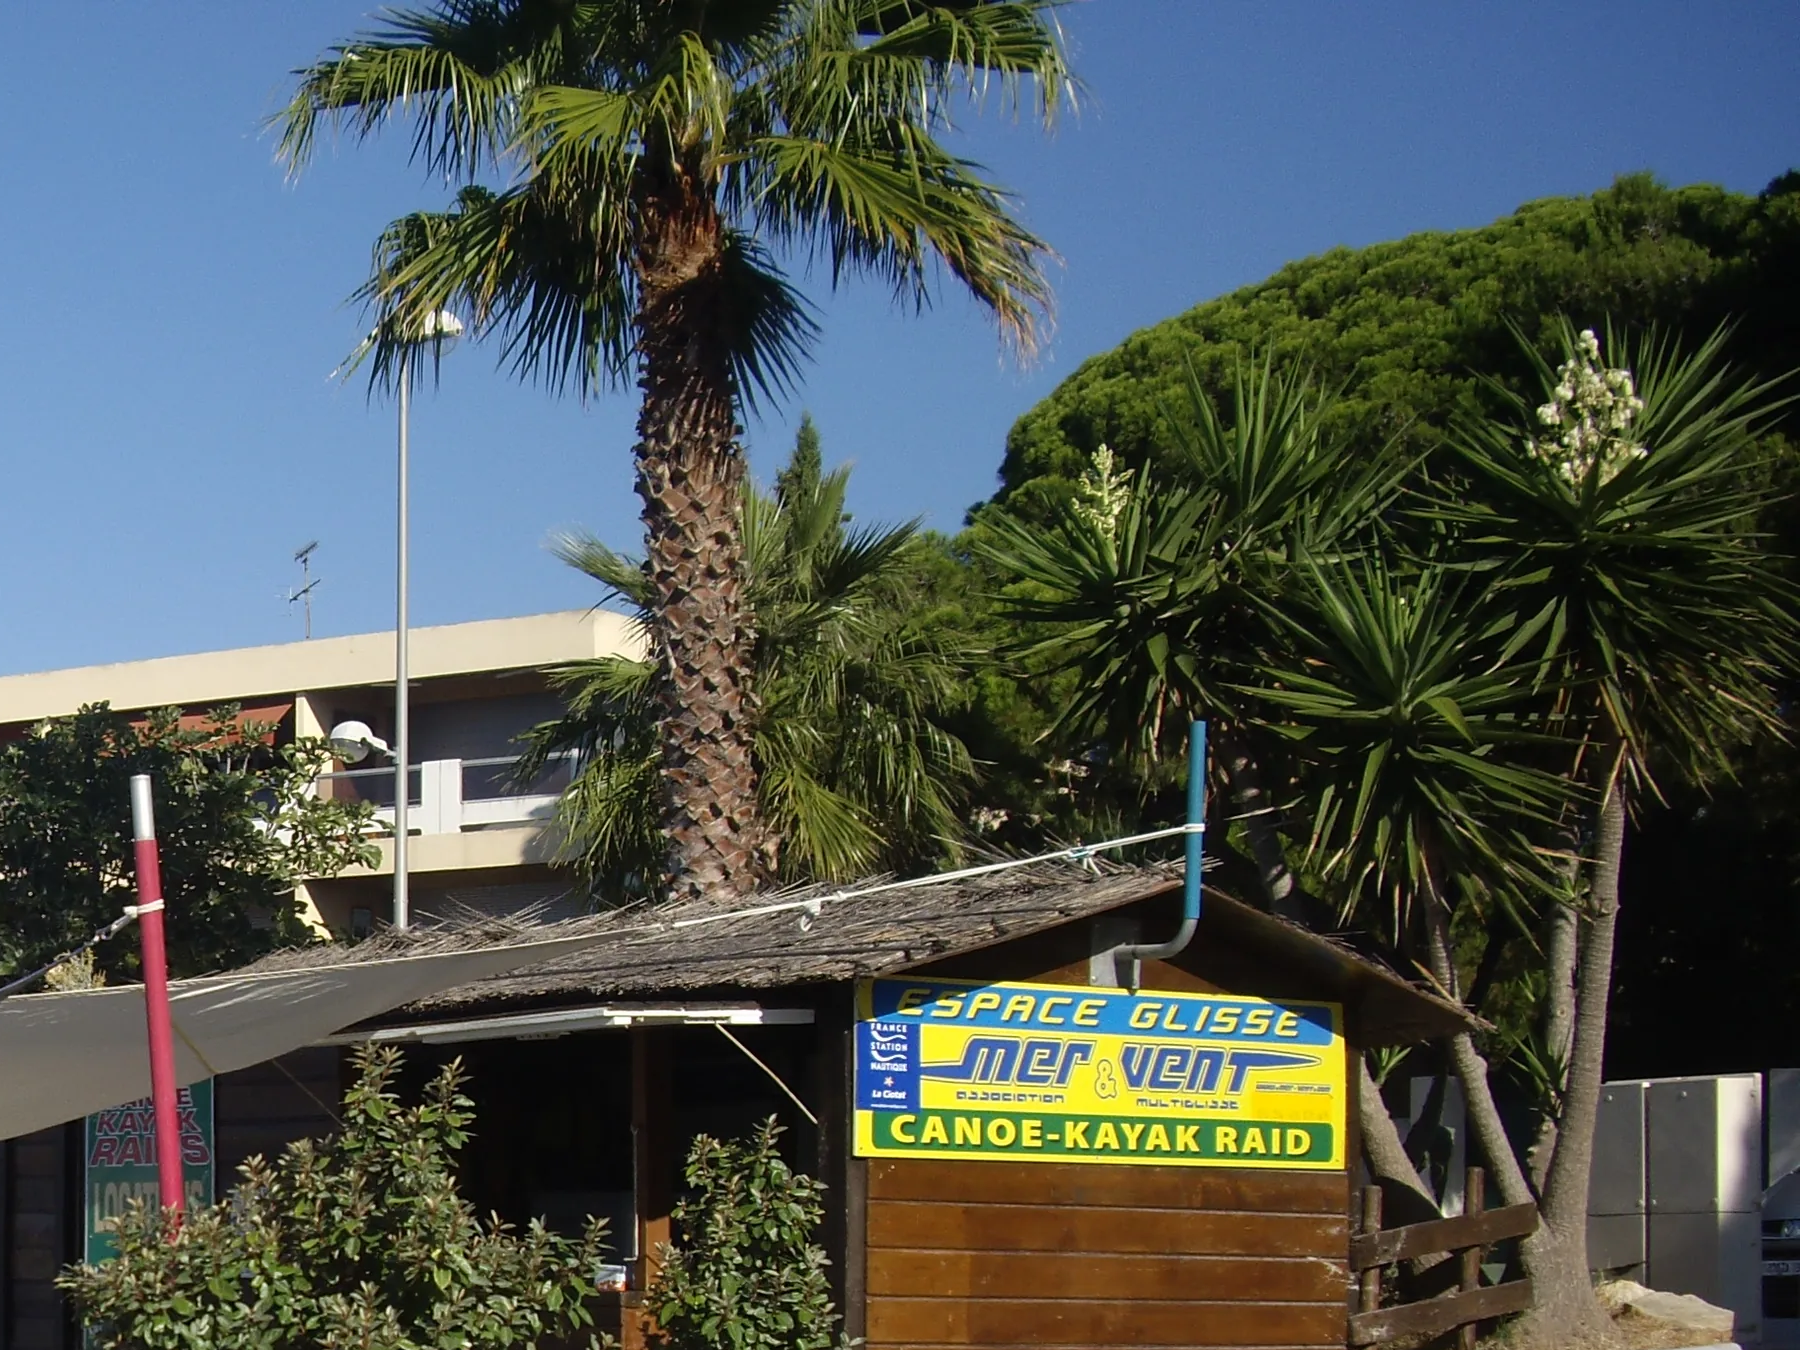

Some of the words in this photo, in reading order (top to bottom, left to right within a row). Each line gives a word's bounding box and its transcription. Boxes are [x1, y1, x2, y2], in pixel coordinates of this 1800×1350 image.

[870, 1023, 907, 1032] FRANCE
[897, 988, 1109, 1027] ESPACE
[1128, 1002, 1303, 1038] GLISSE
[870, 1042, 907, 1051] STATION
[870, 1062, 907, 1072] NAUTIQUE
[1094, 1059, 1117, 1099] &
[96, 1108, 202, 1135] KAYK
[890, 1115, 1200, 1153] CANOE-KAYAK
[1215, 1126, 1313, 1156] RAID
[88, 1134, 210, 1167] RAIS
